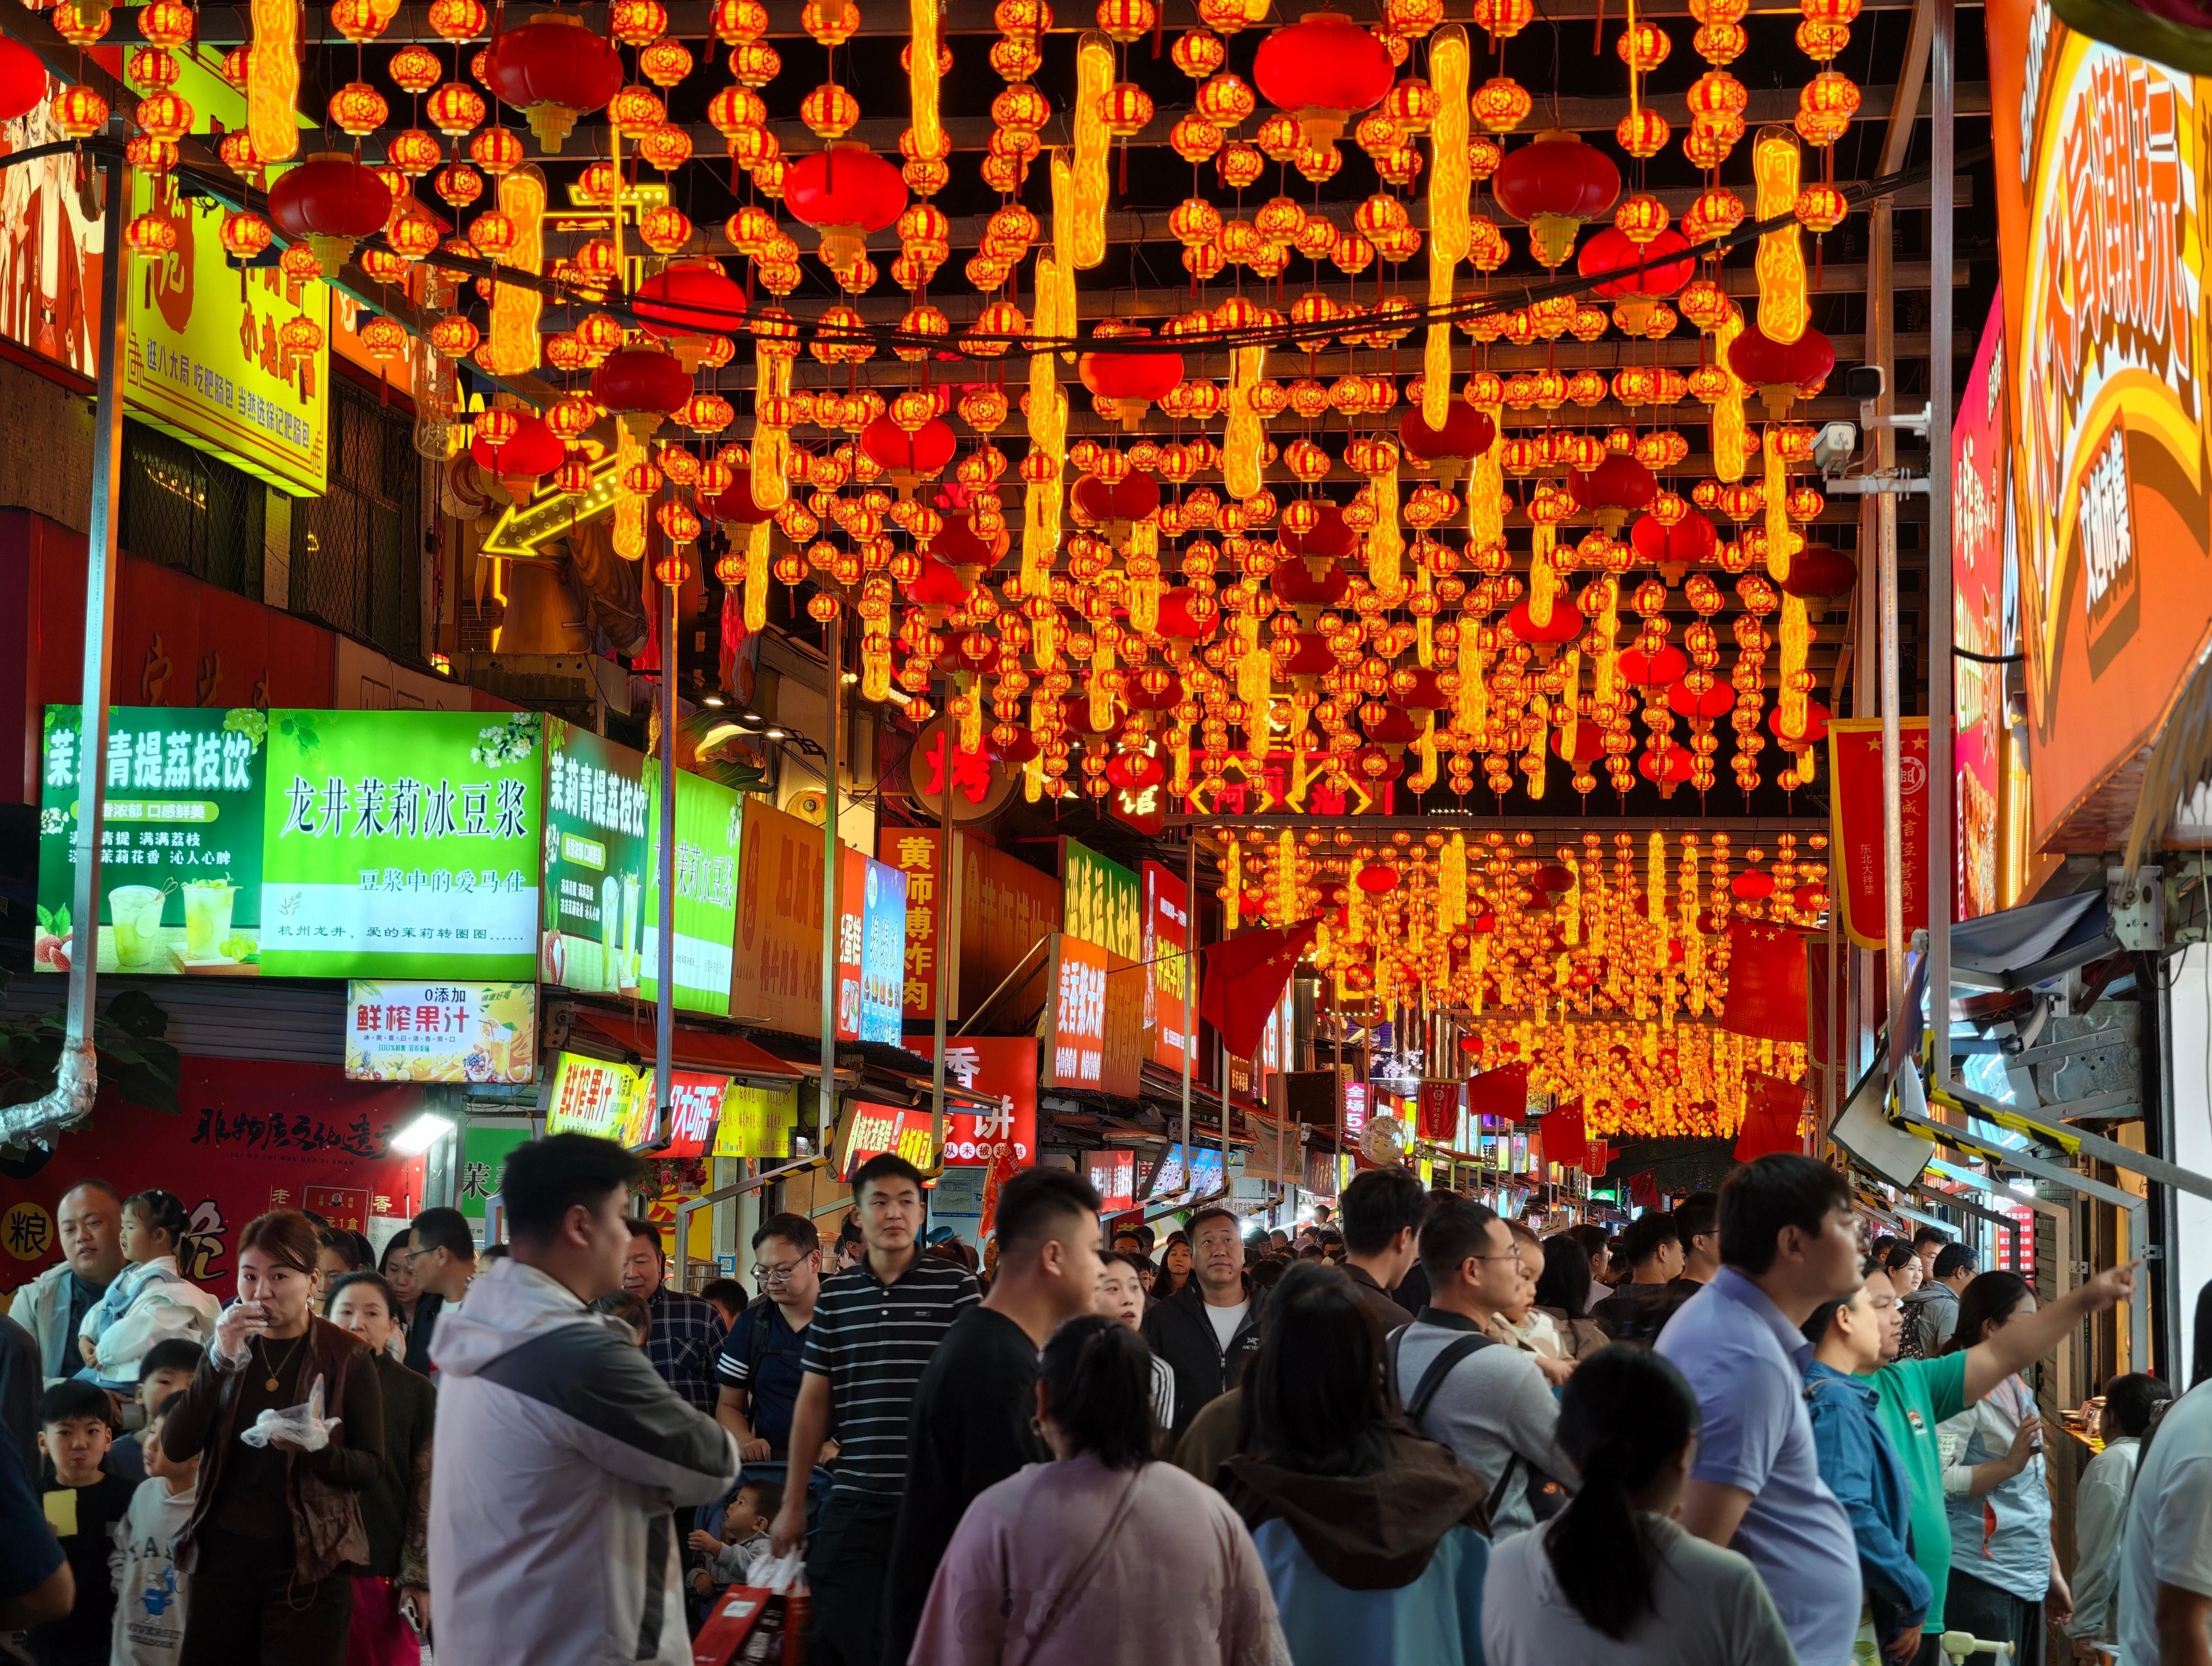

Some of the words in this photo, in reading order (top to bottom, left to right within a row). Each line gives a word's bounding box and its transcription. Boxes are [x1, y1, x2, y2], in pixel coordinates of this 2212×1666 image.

[147, 338, 189, 387] 逛八大局
[194, 364, 233, 409] 吃肥肠包
[239, 387, 309, 448] 当然选徐记肥肠包
[2079, 428, 2131, 615] 文创市集
[47, 728, 250, 789] 茉青提荔枝饮
[923, 731, 994, 804] 烤
[102, 803, 142, 819] 香浓郁
[147, 803, 205, 819] 口感鲜美
[280, 776, 528, 839] 龙井茉莉冰豆浆
[551, 751, 645, 838] 茉莉青提荔枝饮
[140, 832, 201, 847] 满满荔枝
[170, 850, 231, 866] 沁人心脾
[358, 868, 525, 893] 豆浆中的爱马仕
[651, 832, 734, 909] 龙茉莉冰豆浆
[1860, 843, 1875, 896] 东北大拌菜
[840, 913, 861, 966] 蛋糕
[897, 836, 935, 1010] 黄师傅炸肉
[357, 1004, 470, 1033] 鲜榨果汁
[425, 986, 466, 1003] 0添加
[378, 1044, 406, 1052] 100%鲜果
[559, 1062, 613, 1122] 鲜榨果汁
[617, 1074, 634, 1098] 0添加
[272, 1188, 291, 1204] 老
[372, 1195, 393, 1213] 香
[8, 1211, 47, 1254] 粮
